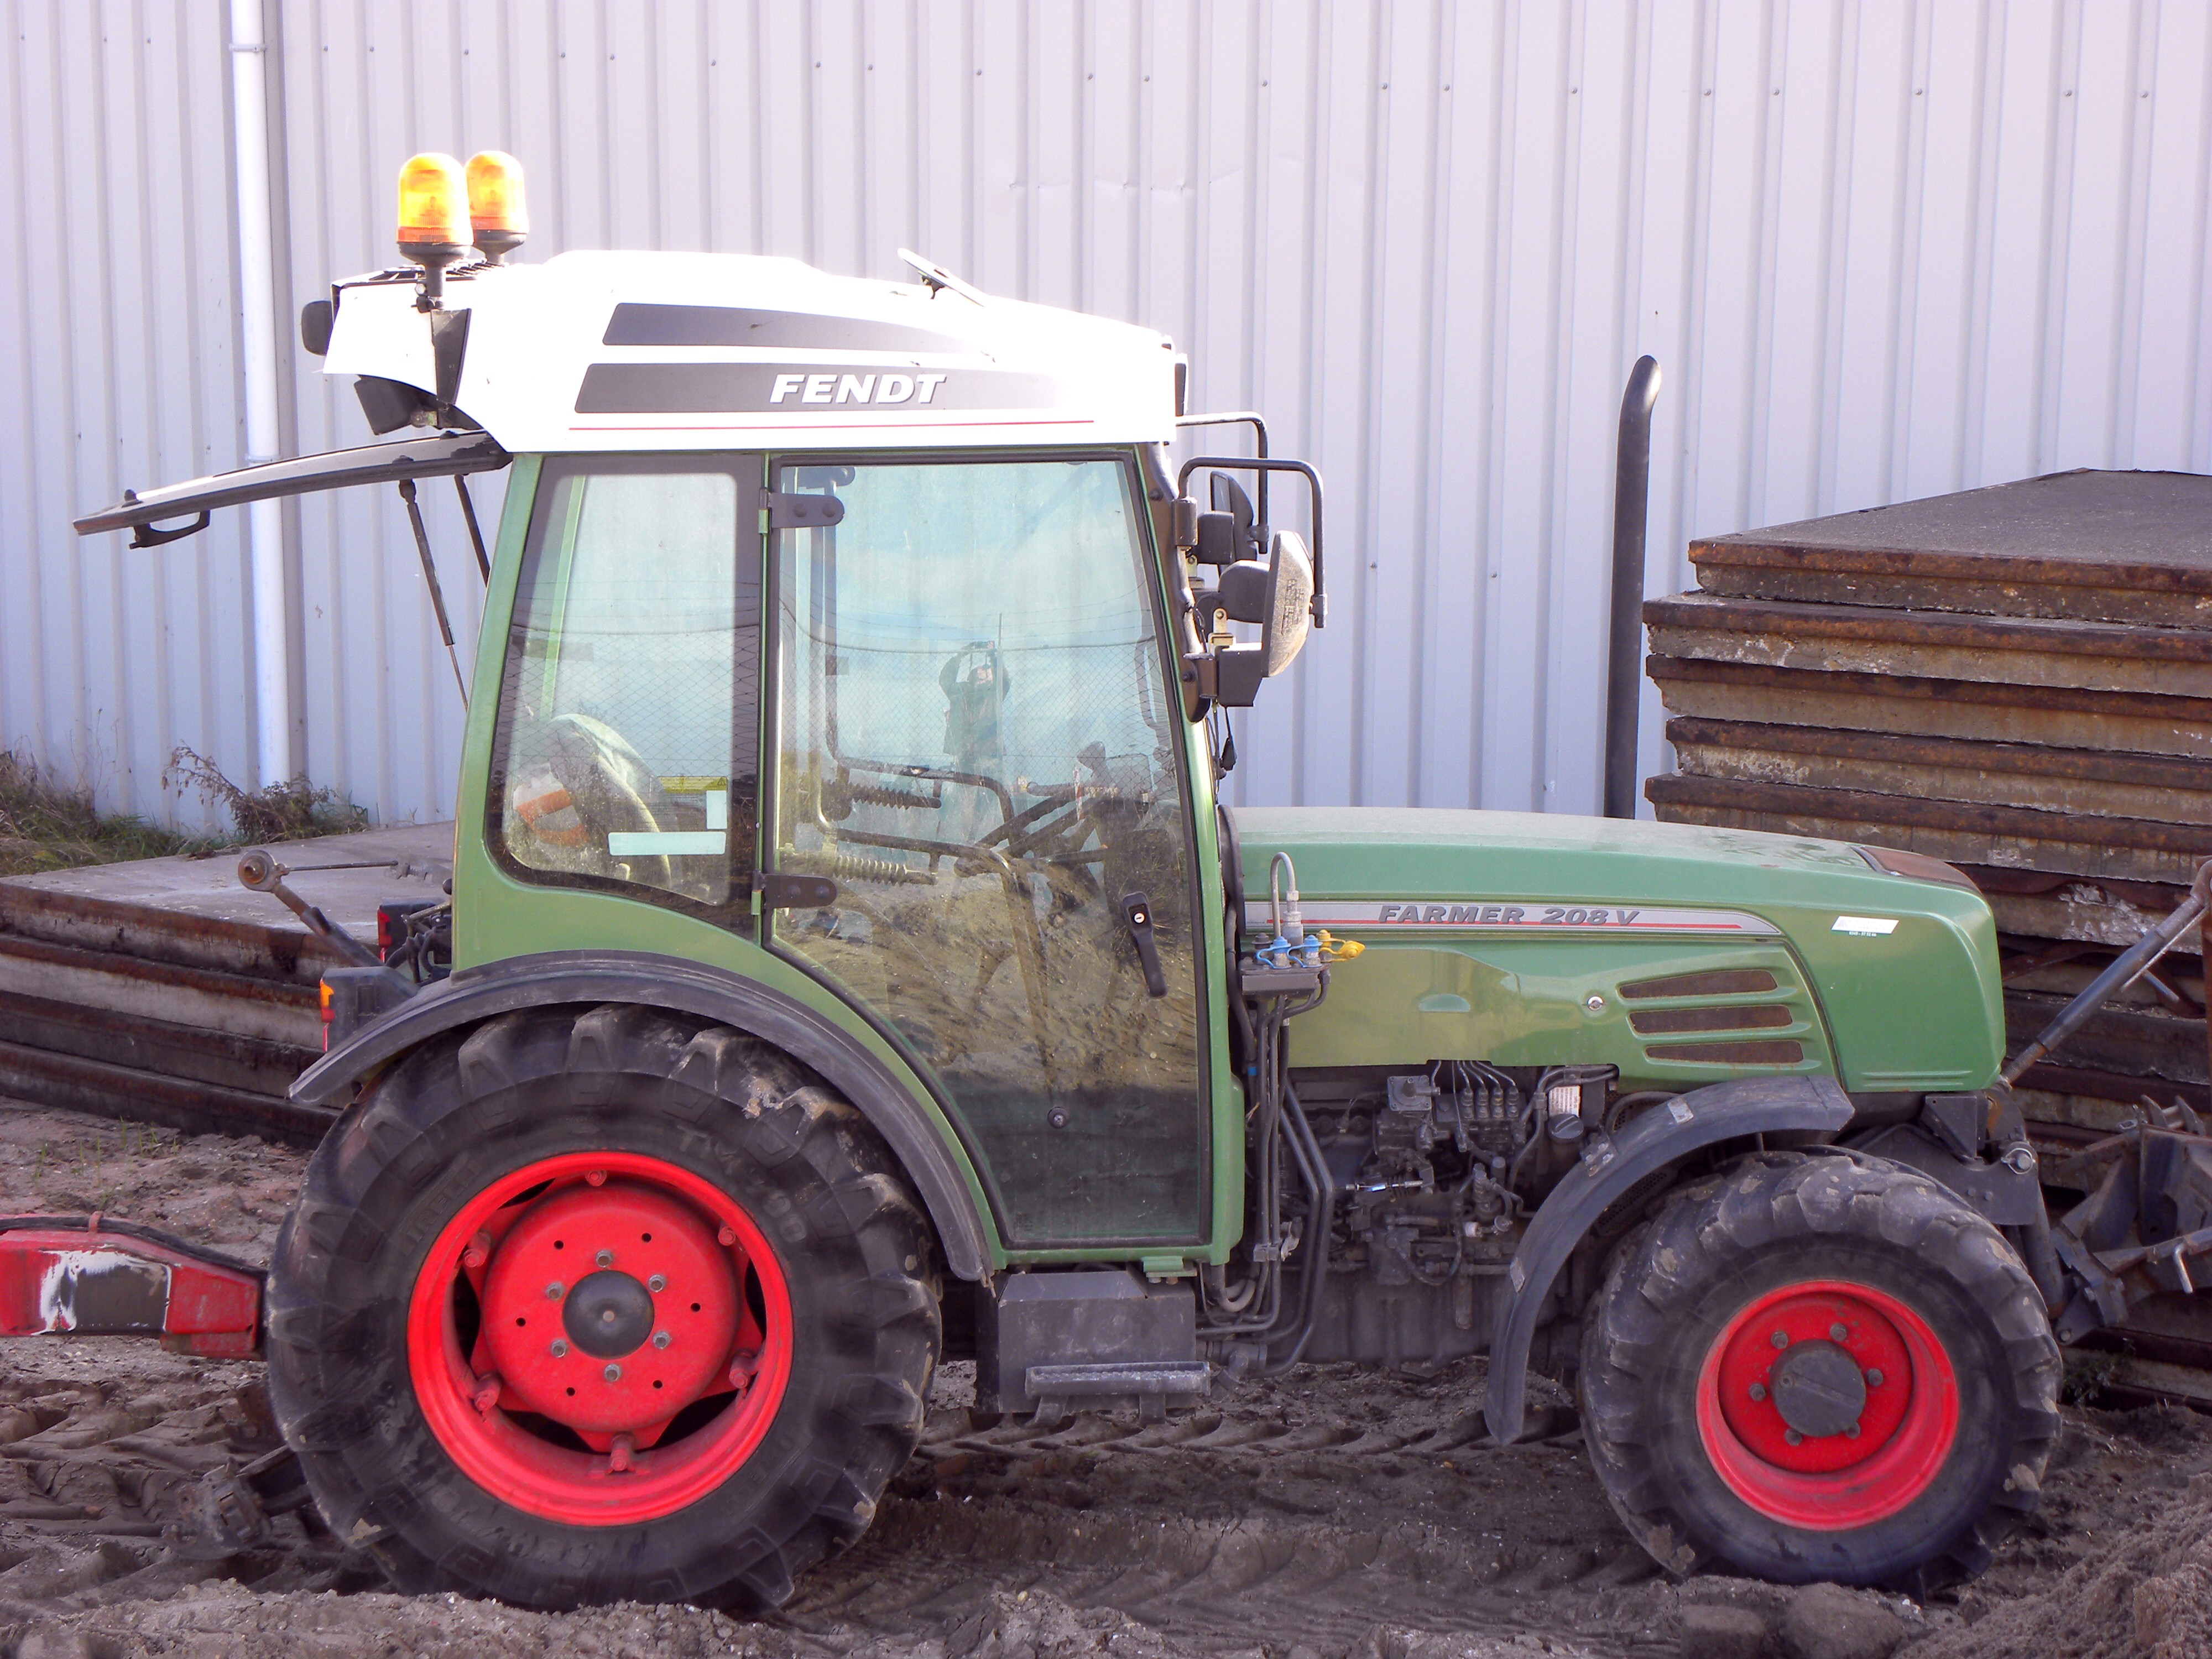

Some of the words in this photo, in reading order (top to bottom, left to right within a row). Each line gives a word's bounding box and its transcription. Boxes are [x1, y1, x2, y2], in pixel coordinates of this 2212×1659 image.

[769, 374, 947, 404] FENDT
[1379, 905, 1525, 924] FARMER
[1541, 907, 1608, 926] 208
[1616, 910, 1641, 926] V
